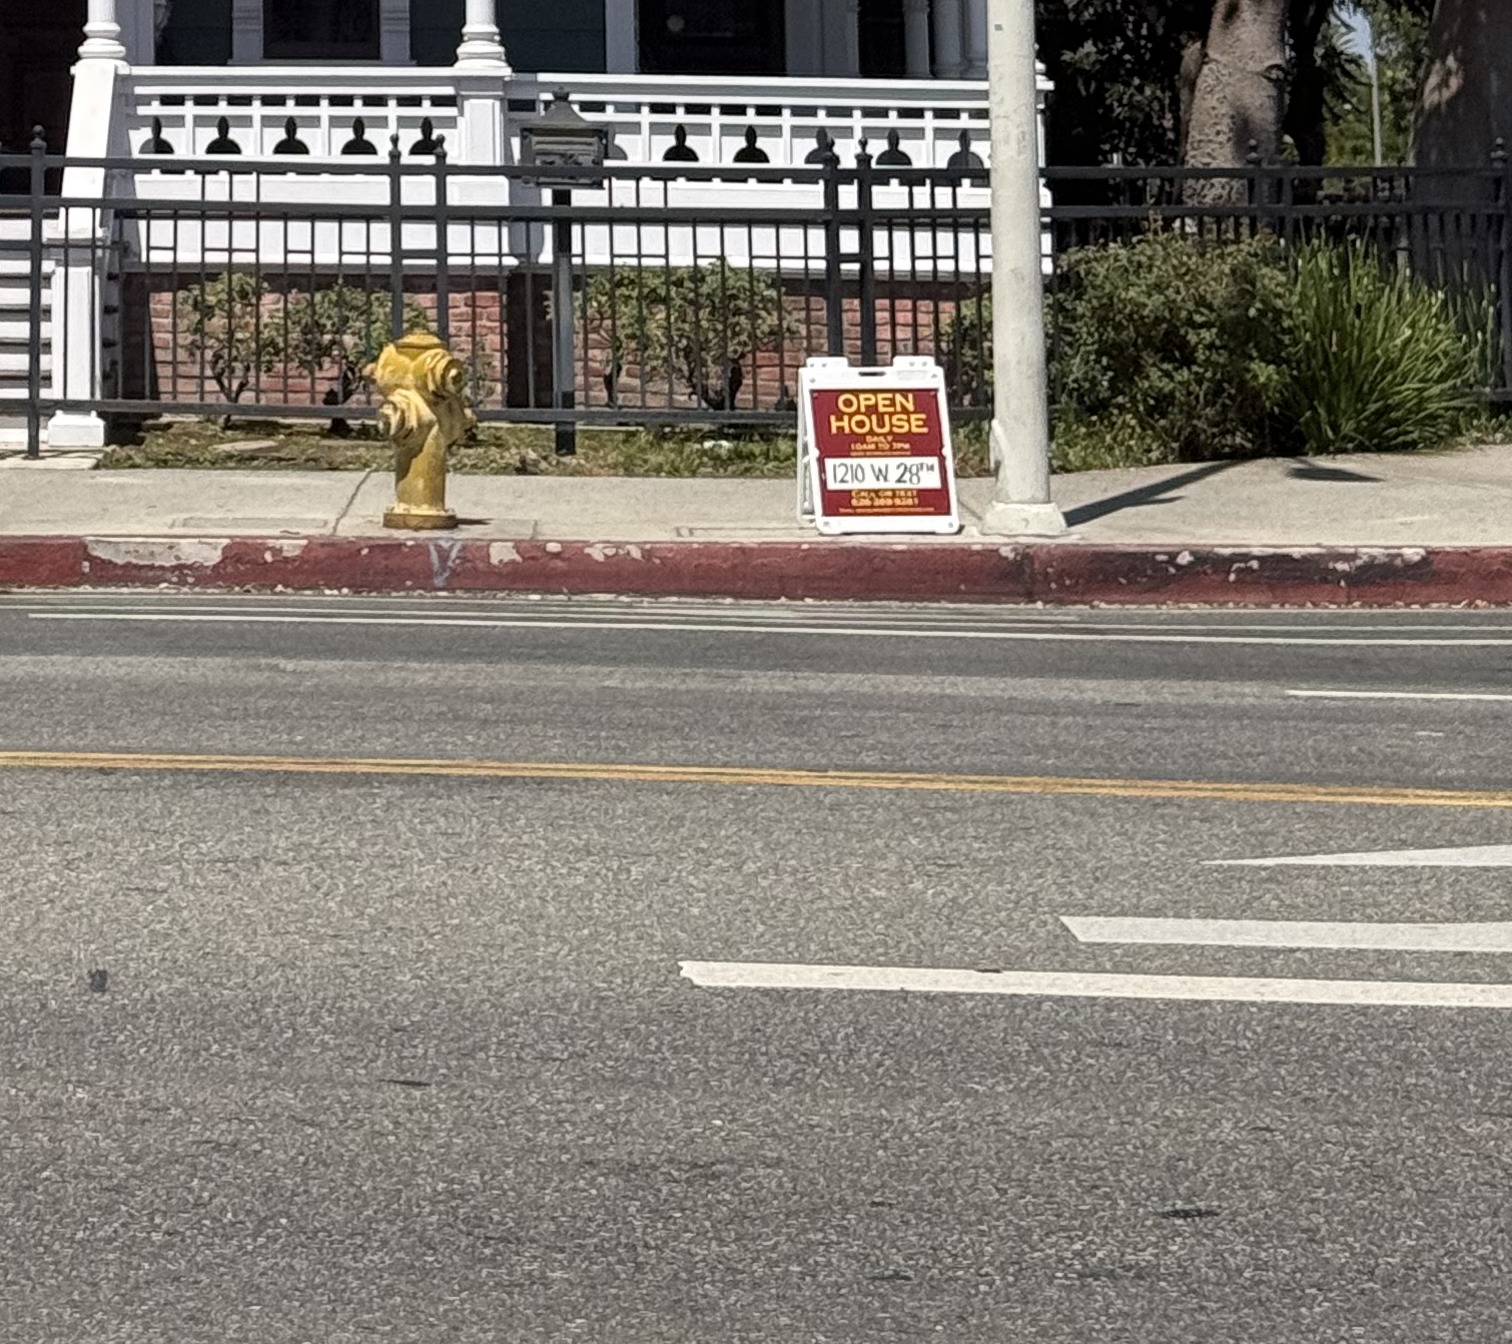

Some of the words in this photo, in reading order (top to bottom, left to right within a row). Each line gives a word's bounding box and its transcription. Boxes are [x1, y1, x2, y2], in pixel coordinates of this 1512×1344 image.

[838, 393, 915, 413] OPEN
[830, 414, 929, 434] HOUSE
[833, 463, 865, 483] 1210
